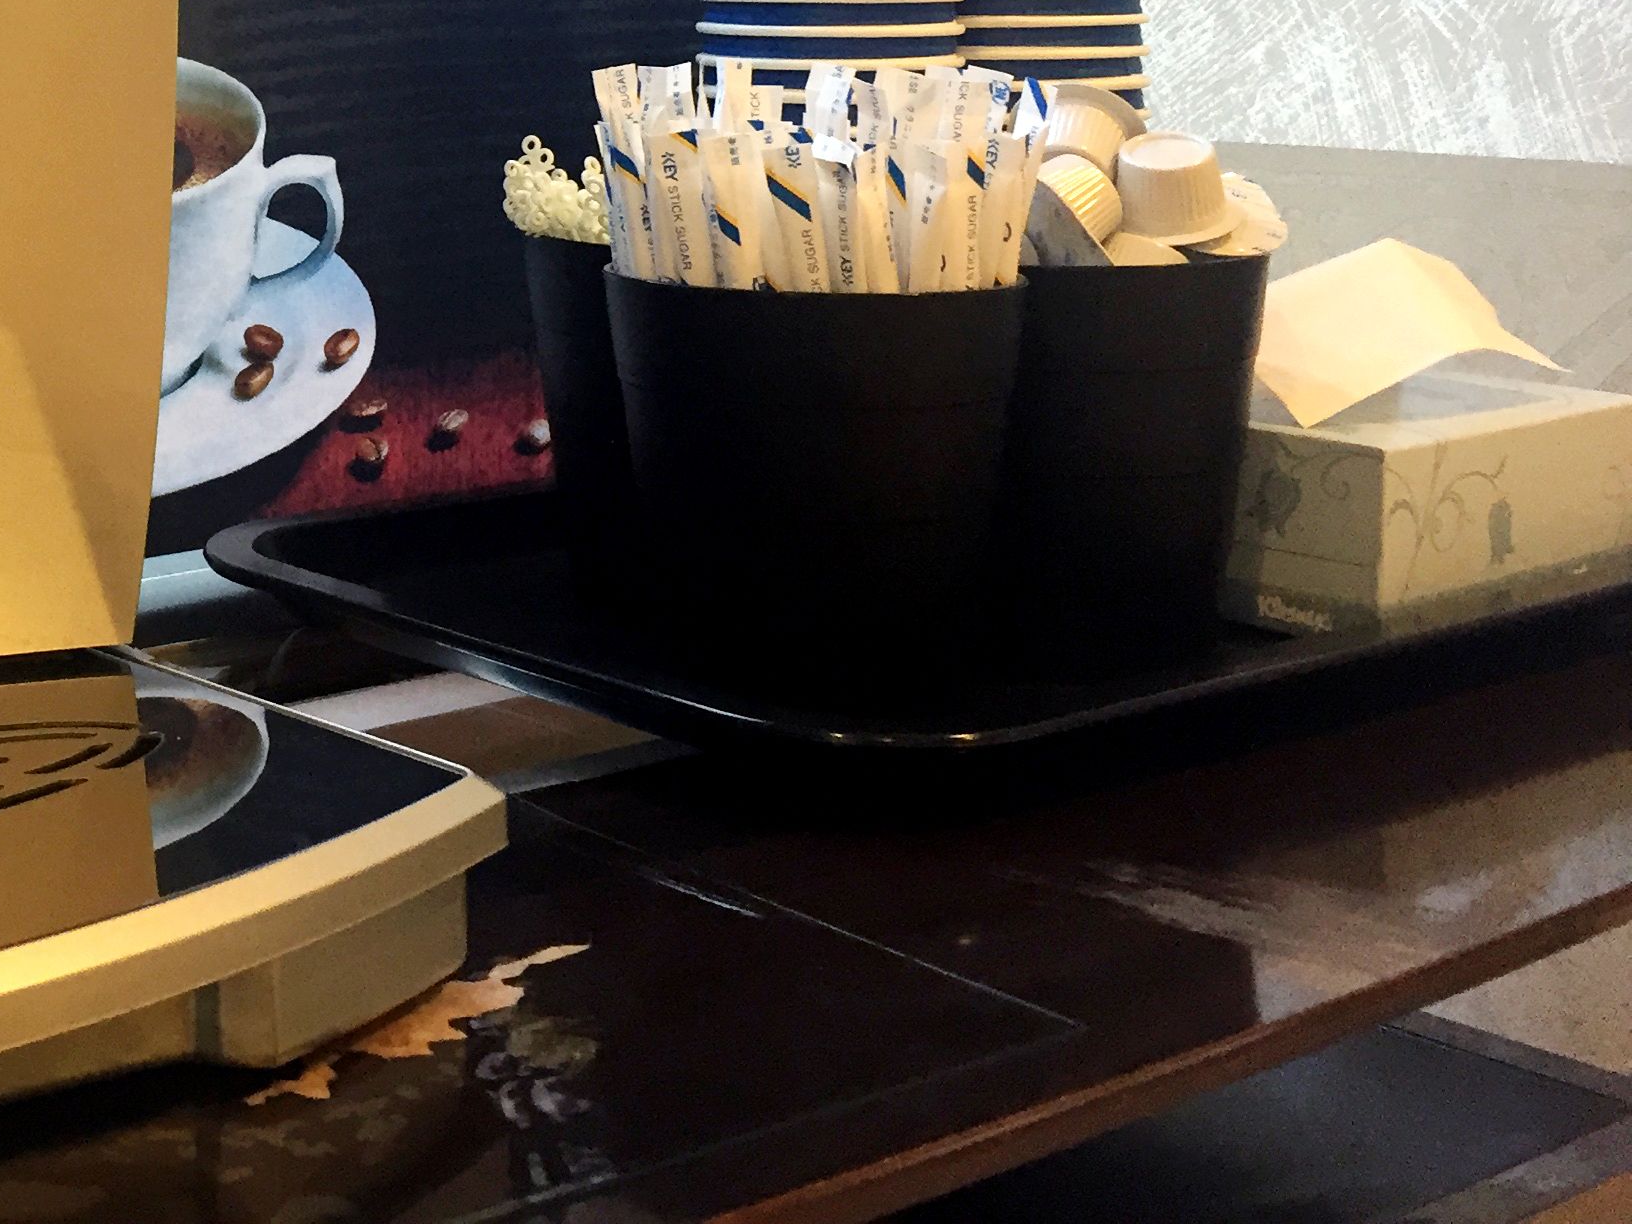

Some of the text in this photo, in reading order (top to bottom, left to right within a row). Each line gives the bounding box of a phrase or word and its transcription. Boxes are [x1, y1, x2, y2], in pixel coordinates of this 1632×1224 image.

[615, 68, 632, 110] SUGAR
[749, 91, 762, 120] TICK
[958, 81, 970, 101] ICK
[785, 145, 802, 169] KE
[985, 139, 1000, 170] KEY
[660, 151, 693, 271] KEY STICK SUGAR
[967, 195, 977, 242] SUGAR
[840, 214, 851, 253] STICK
[801, 229, 820, 274] SUGAR
[840, 255, 855, 286] KEY
